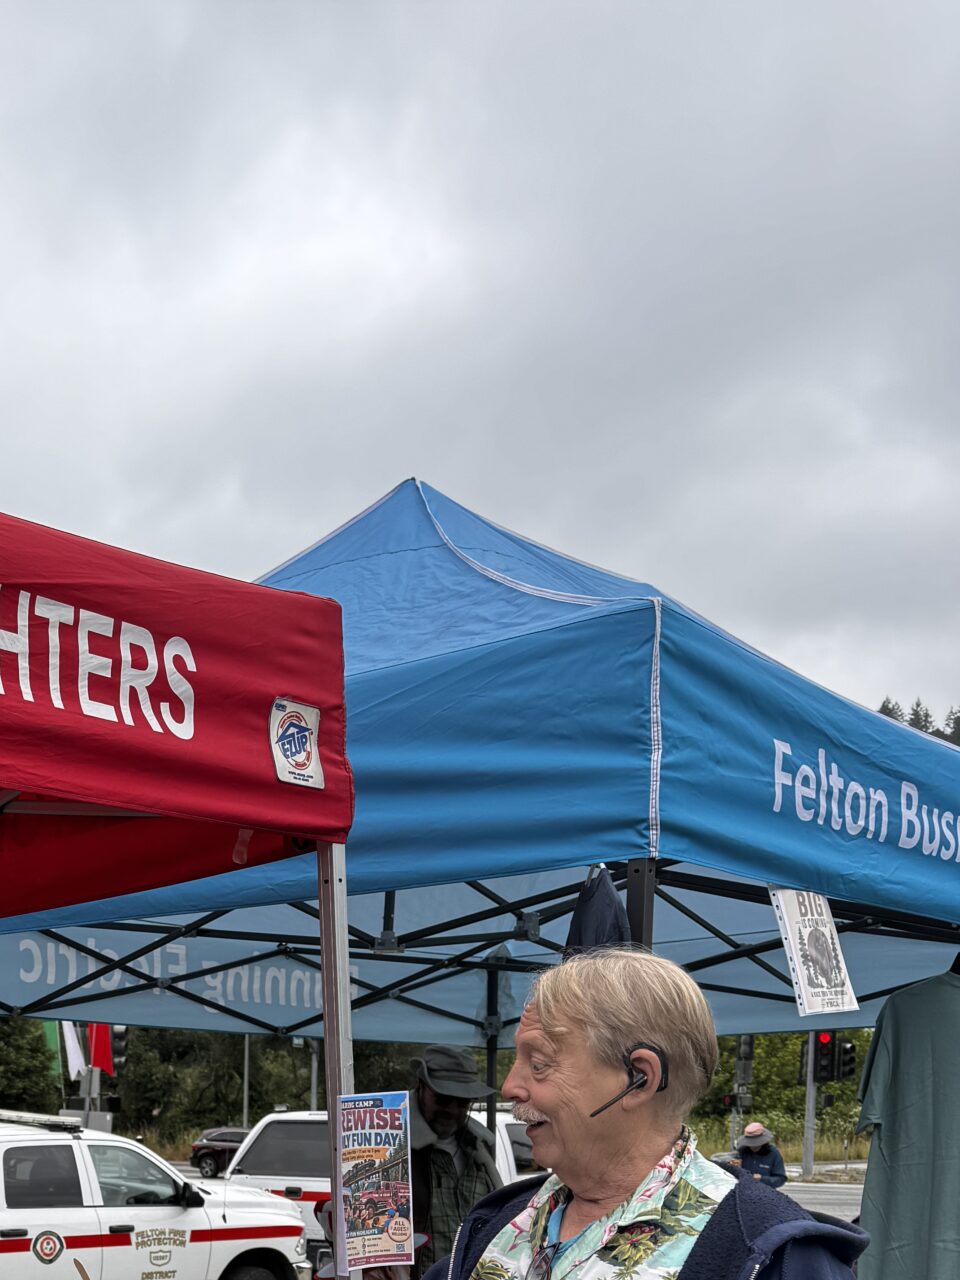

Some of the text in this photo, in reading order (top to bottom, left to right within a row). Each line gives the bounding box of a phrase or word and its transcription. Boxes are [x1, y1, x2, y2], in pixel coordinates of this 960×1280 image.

[772, 739, 889, 843] Felton
[796, 891, 825, 918] BIG
[352, 1133, 372, 1146] FUN
[374, 1132, 399, 1147] DAY
[135, 1228, 187, 1240] FELTON FIRE
[135, 1237, 187, 1250] PROTECTION
[141, 1270, 178, 1280] DISTRICT
